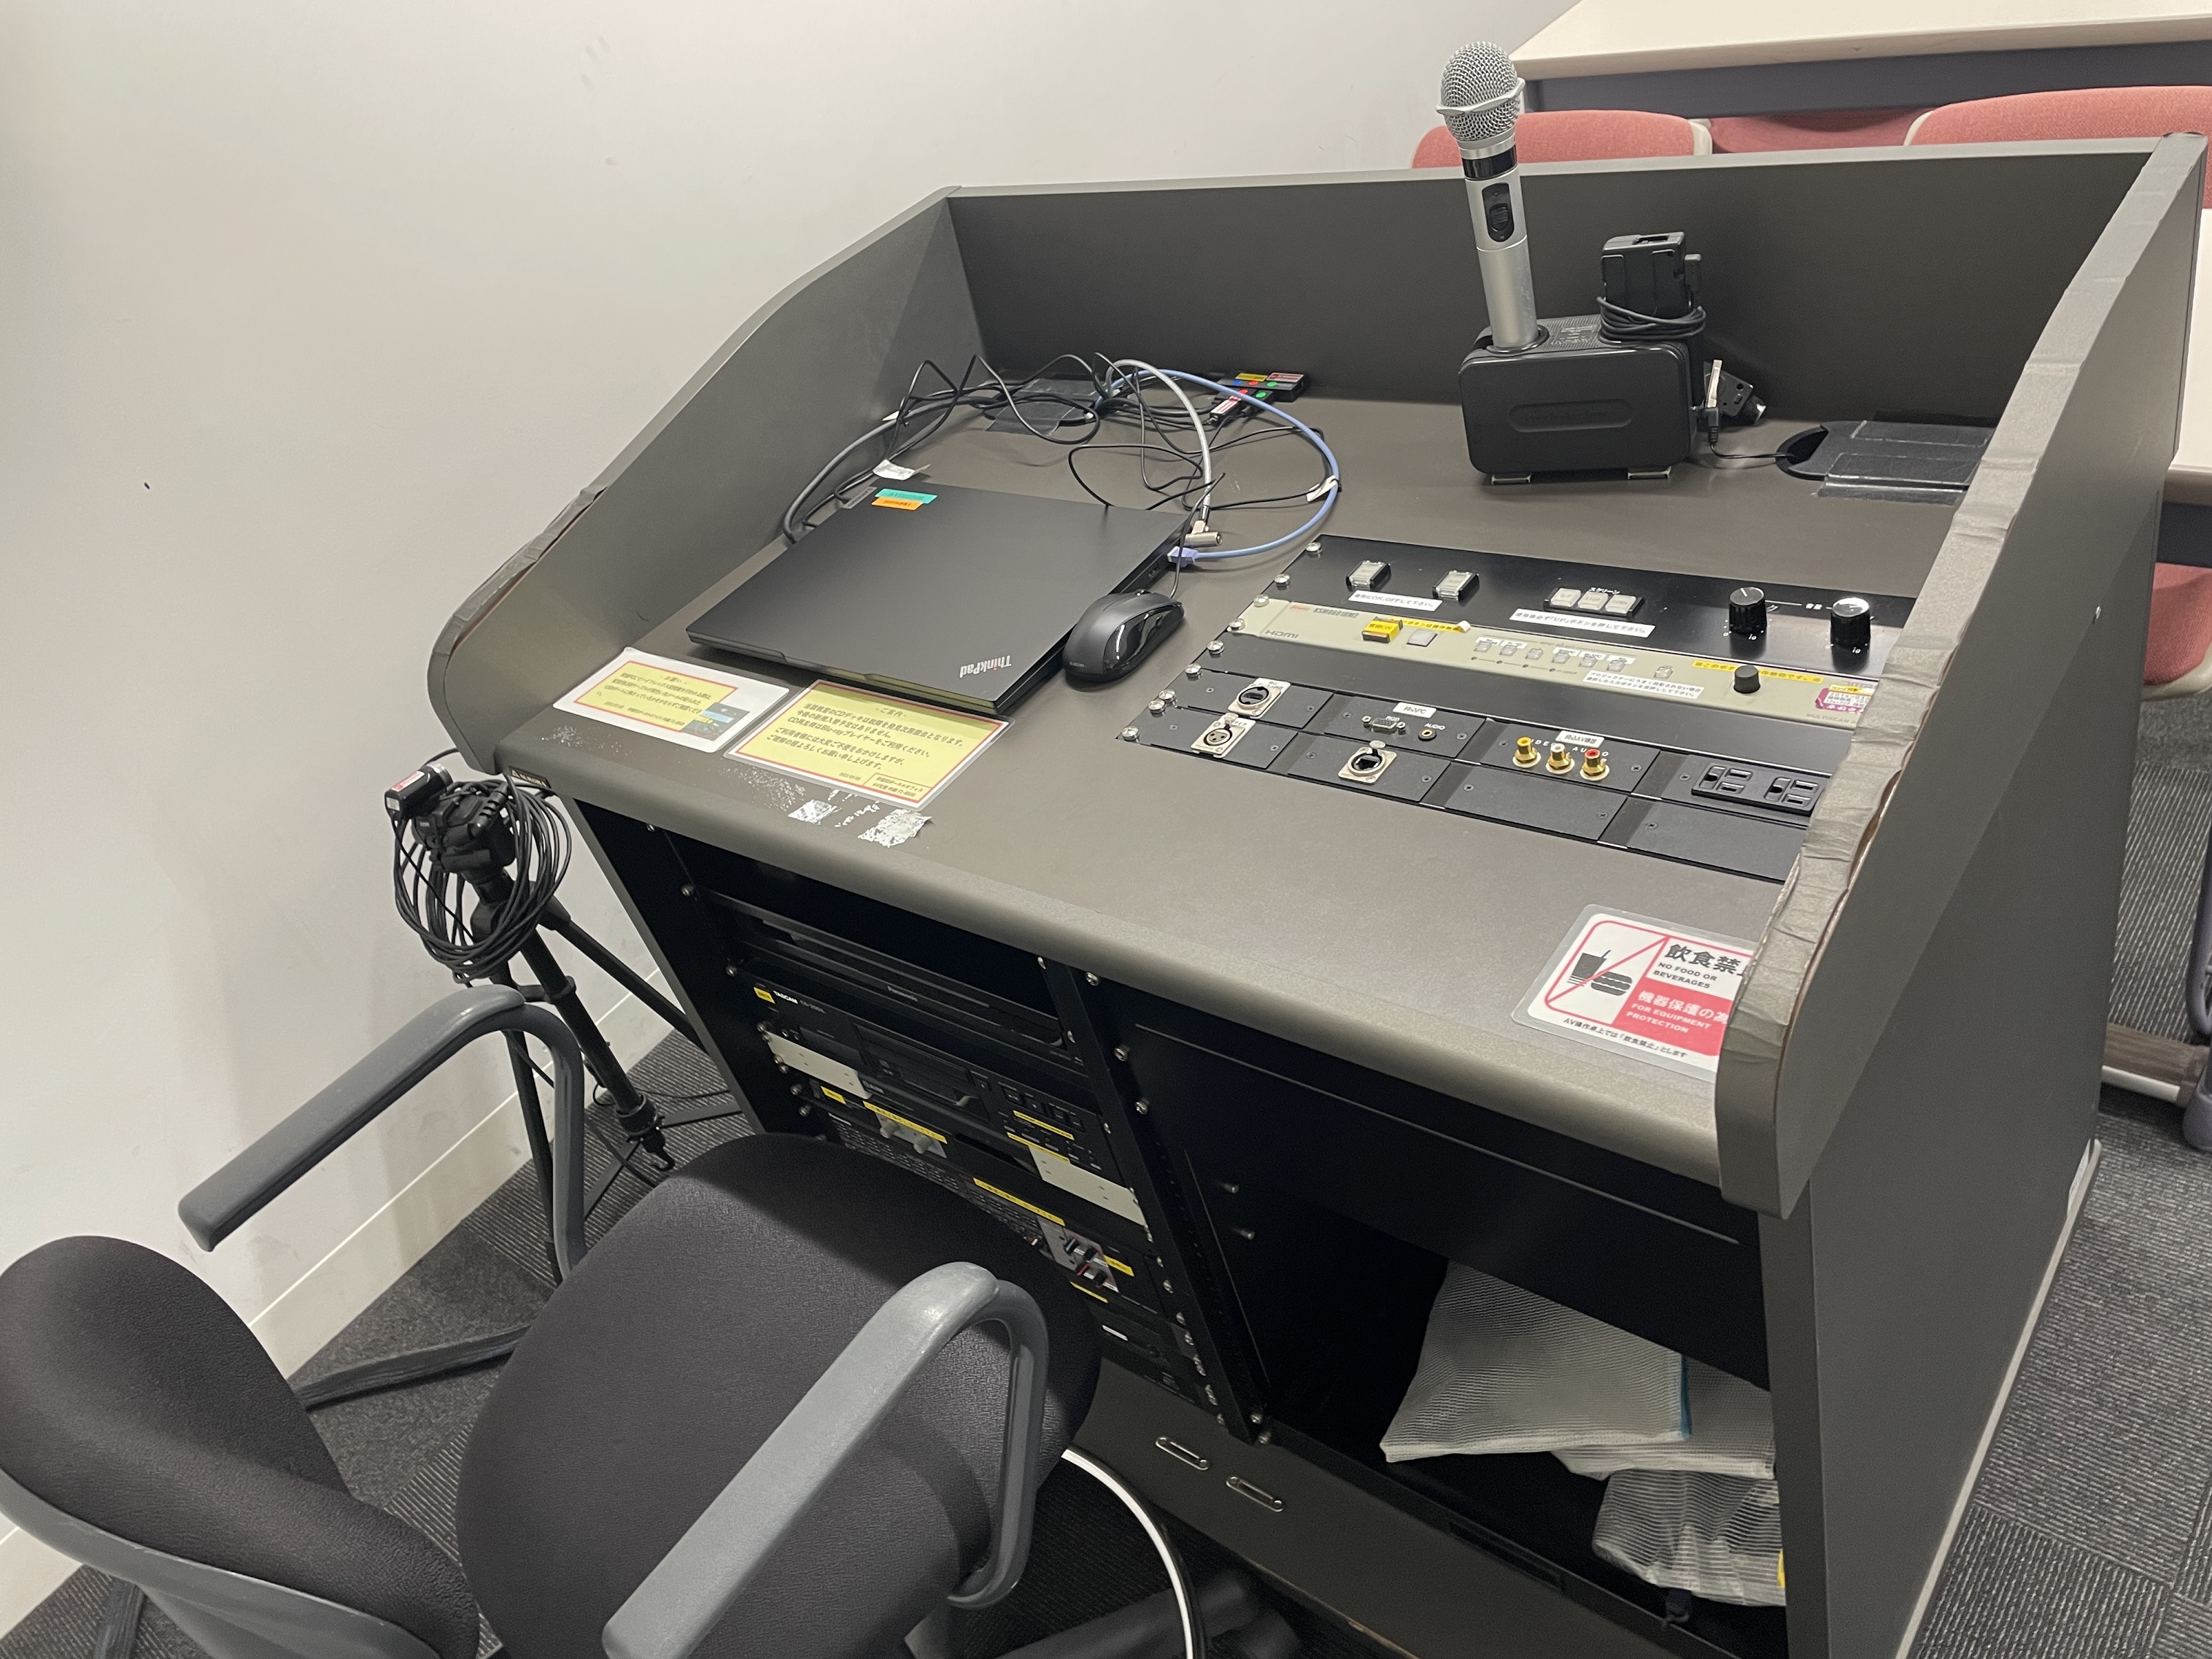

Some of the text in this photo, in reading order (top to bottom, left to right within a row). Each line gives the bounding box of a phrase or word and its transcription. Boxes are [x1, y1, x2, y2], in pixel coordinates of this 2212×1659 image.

[1264, 630, 1299, 639] HDMI
[959, 655, 1012, 678] ThinkPad
[1424, 722, 1446, 730] AUDIO
[1664, 943, 1744, 977] 飲食禁
[1653, 970, 1711, 989] BEVERAGES
[1674, 966, 1701, 977] FOOD
[1703, 973, 1717, 981] OR
[772, 990, 799, 1005] TASCAM
[1626, 1011, 1690, 1033] PROTECTION
[1631, 1003, 1712, 1029] FOR EQUIPMENT
